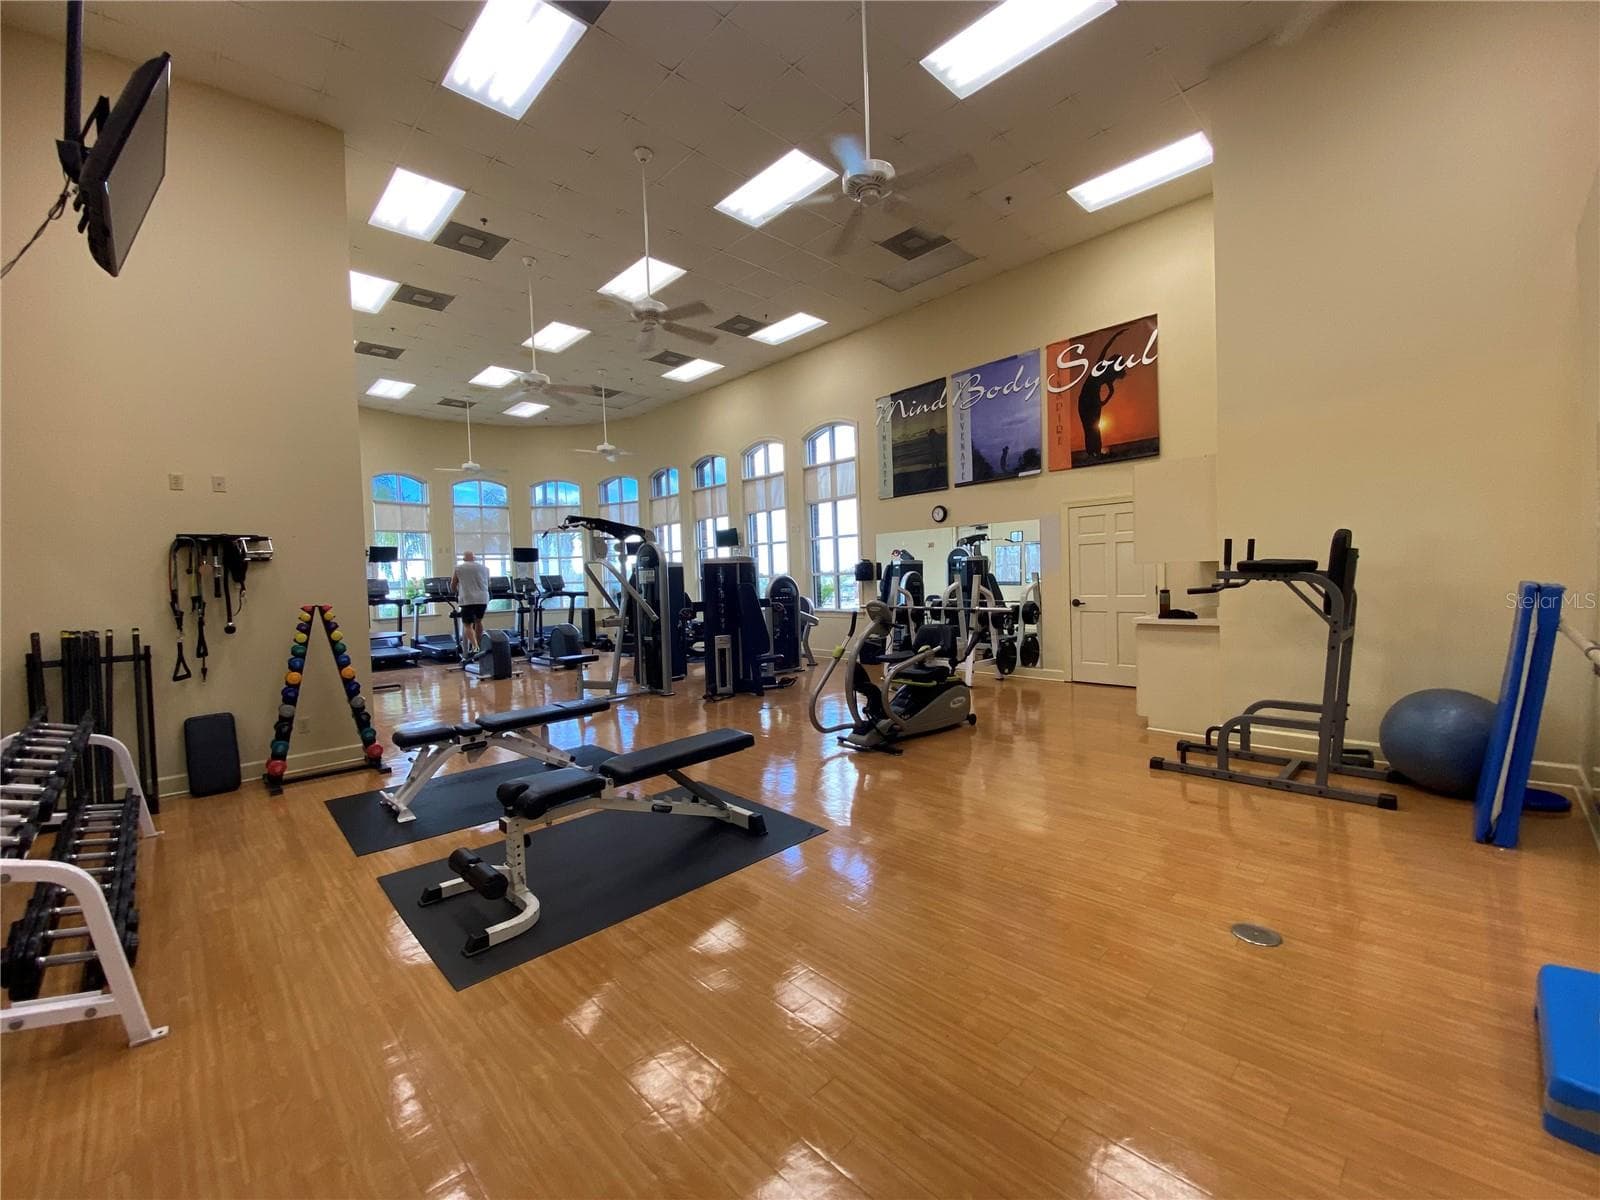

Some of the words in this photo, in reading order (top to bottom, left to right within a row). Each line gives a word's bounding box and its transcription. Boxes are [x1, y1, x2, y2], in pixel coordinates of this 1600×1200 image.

[1047, 329, 1158, 393] Soul
[875, 387, 947, 426] Mind
[952, 365, 1041, 410] Body
